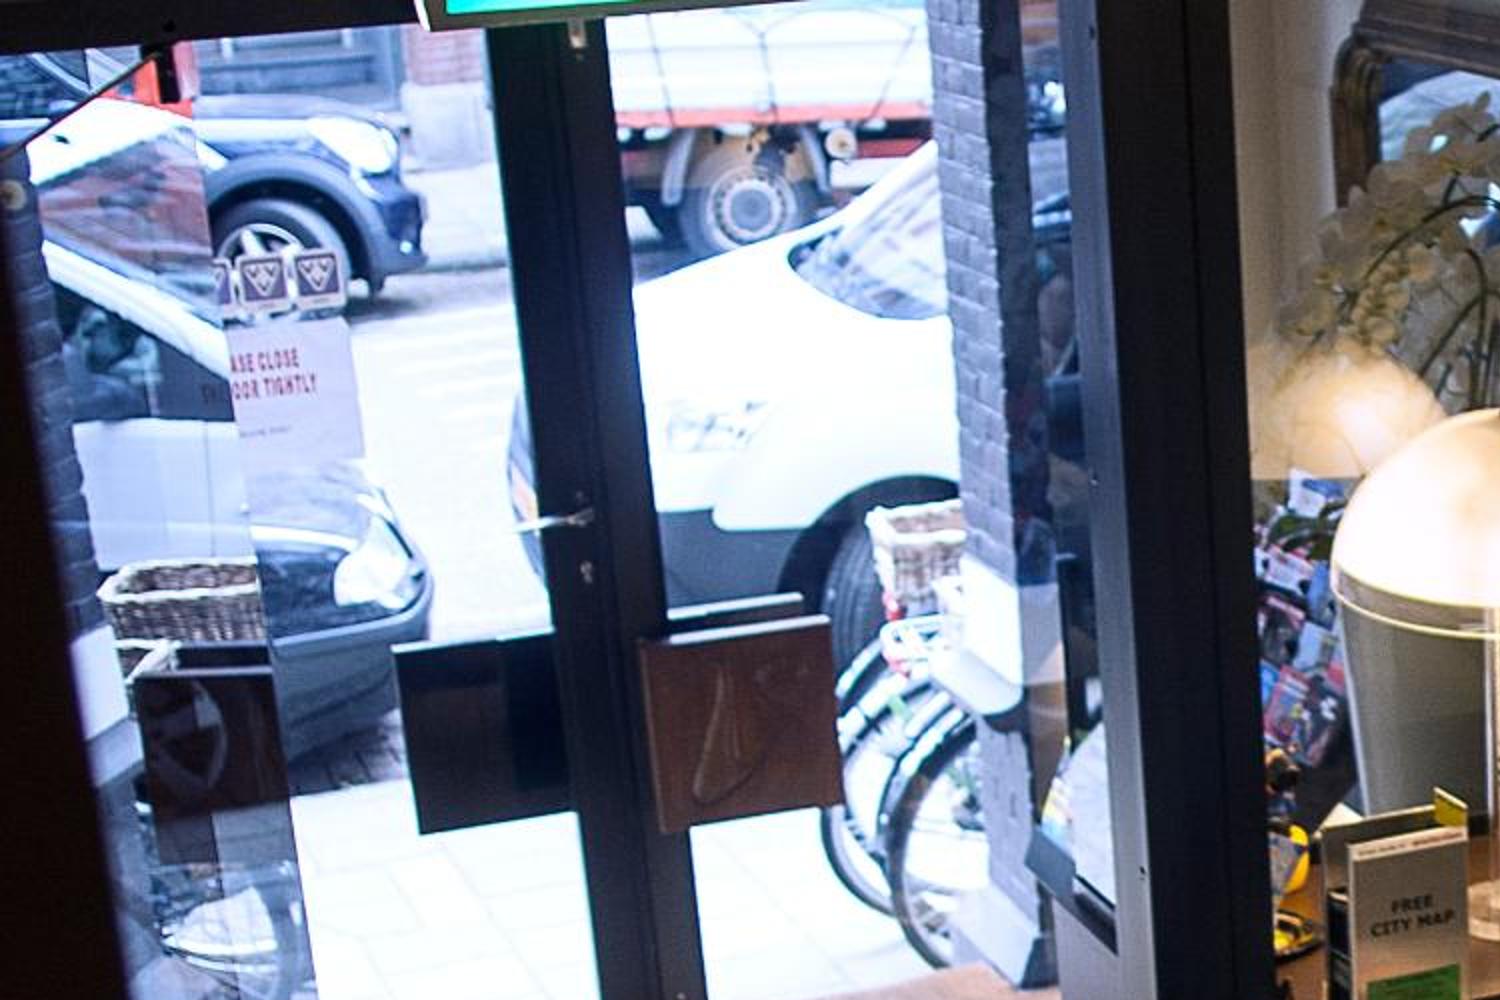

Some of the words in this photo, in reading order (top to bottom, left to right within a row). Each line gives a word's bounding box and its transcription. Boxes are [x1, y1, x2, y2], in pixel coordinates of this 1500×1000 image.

[230, 352, 255, 373] ASE
[257, 347, 300, 372] CLOSE
[232, 378, 260, 400] OOR
[263, 372, 317, 396] TIGHTLY
[1390, 893, 1433, 915] FREE
[1370, 917, 1410, 938] CITY
[1416, 908, 1456, 927] MAP
